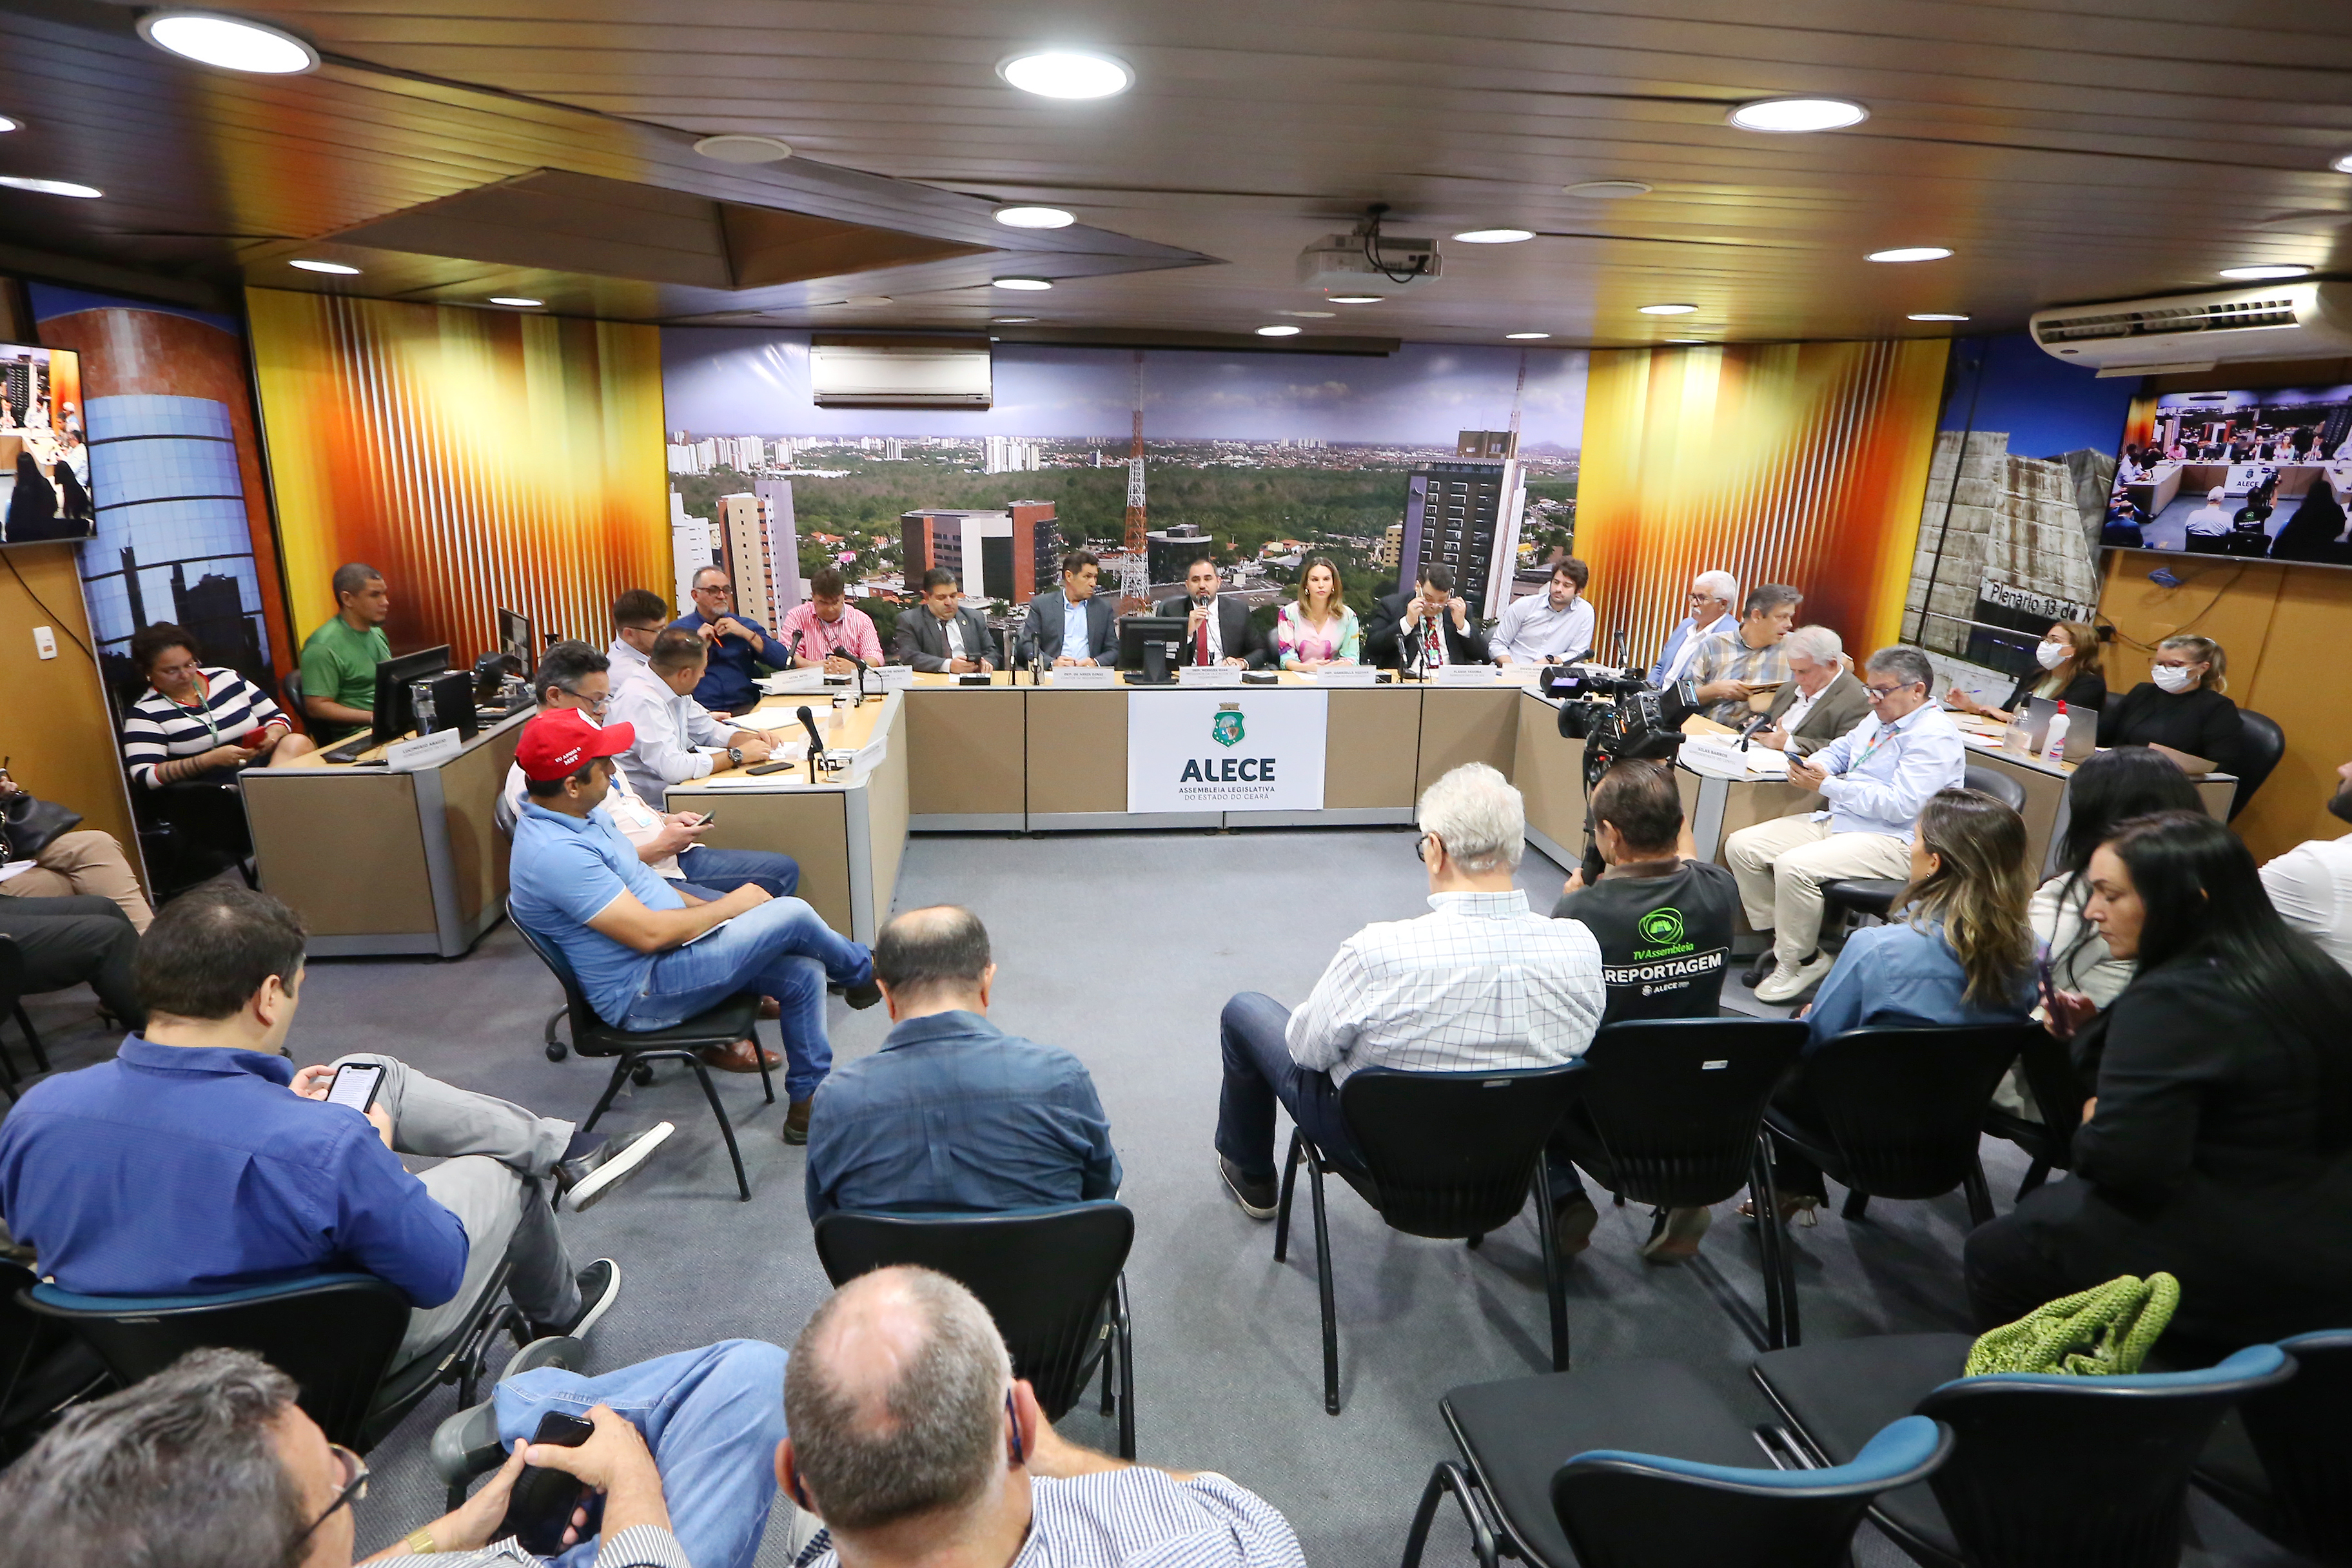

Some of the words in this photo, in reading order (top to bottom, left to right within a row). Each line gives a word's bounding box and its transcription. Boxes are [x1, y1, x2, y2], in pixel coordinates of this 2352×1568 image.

[2044, 600, 2057, 615] 13
[562, 749, 578, 760] APOIO
[563, 754, 579, 766] MST
[1180, 758, 1276, 782] ALECE
[1633, 950, 1645, 961] TV
[1645, 942, 1694, 959] Assembleia
[1604, 952, 1723, 984] REPORTAGEM
[1653, 982, 1678, 994] ALECE
